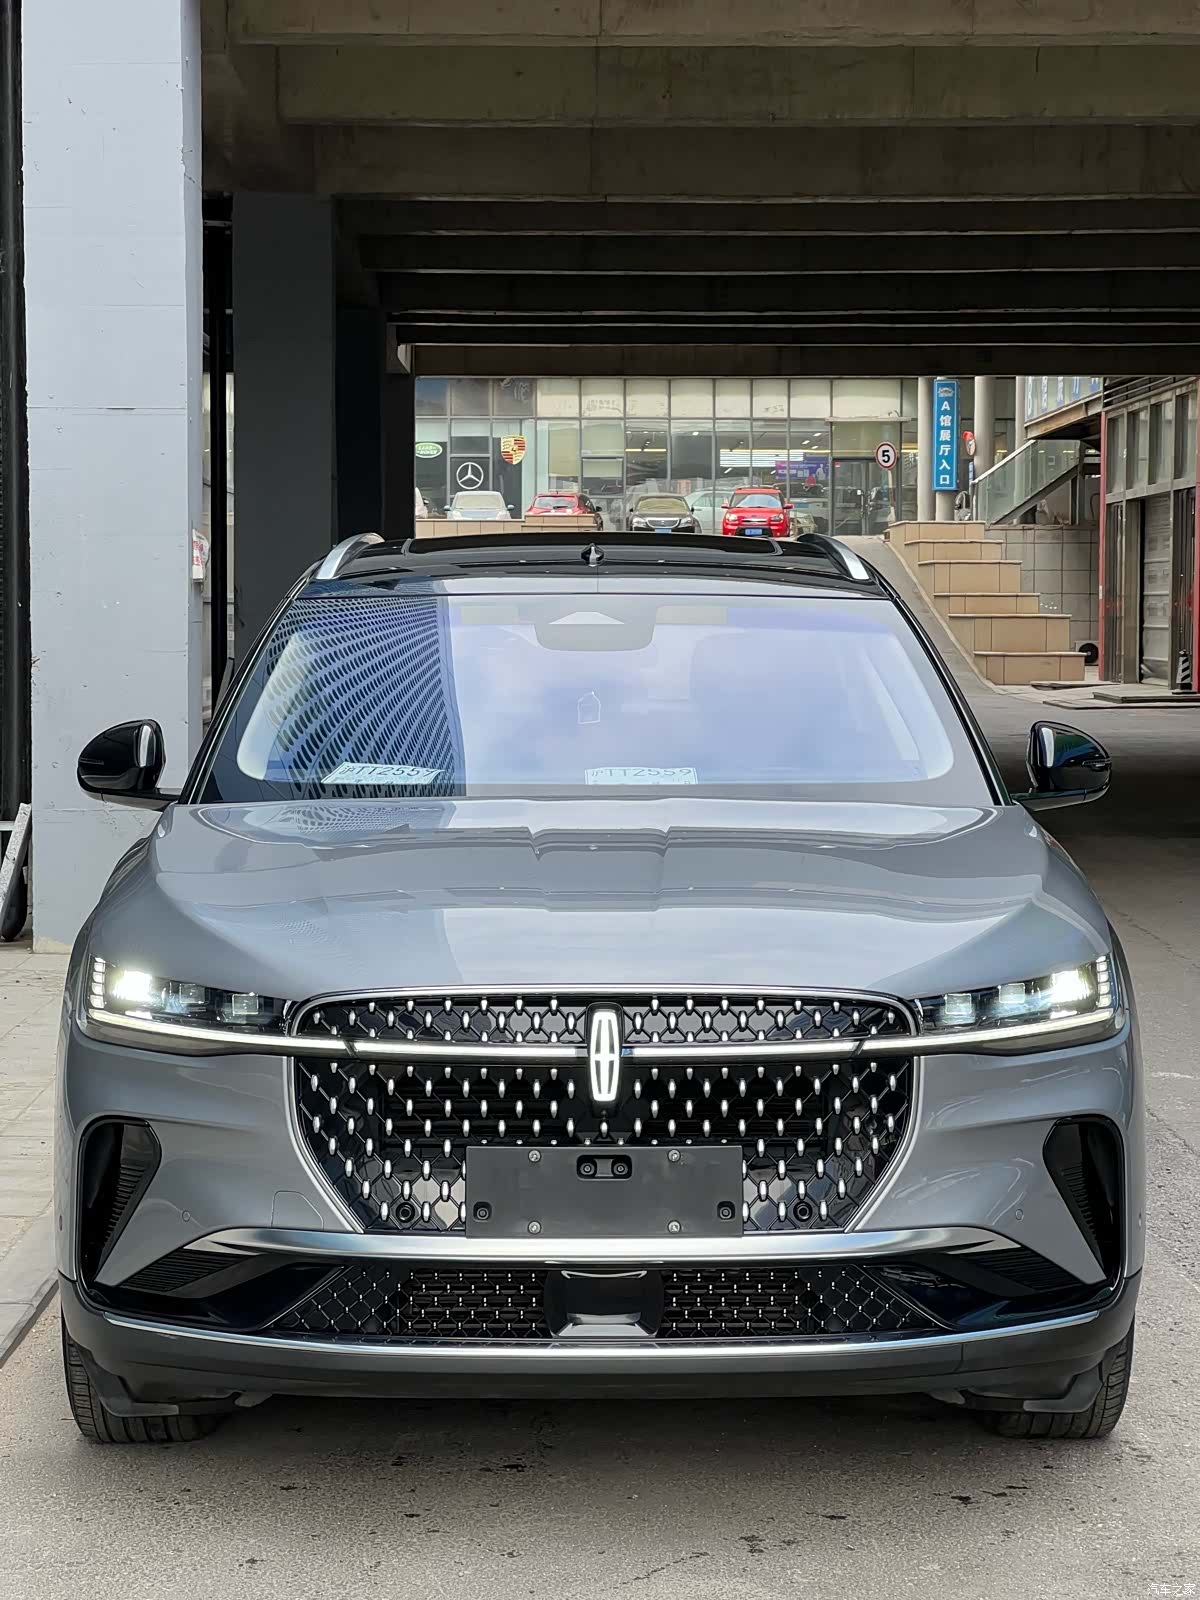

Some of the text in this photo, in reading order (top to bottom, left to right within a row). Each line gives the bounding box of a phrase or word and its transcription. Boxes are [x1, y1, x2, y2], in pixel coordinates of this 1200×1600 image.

[882, 450, 891, 463] 5
[939, 401, 952, 485] A馆展厅入口
